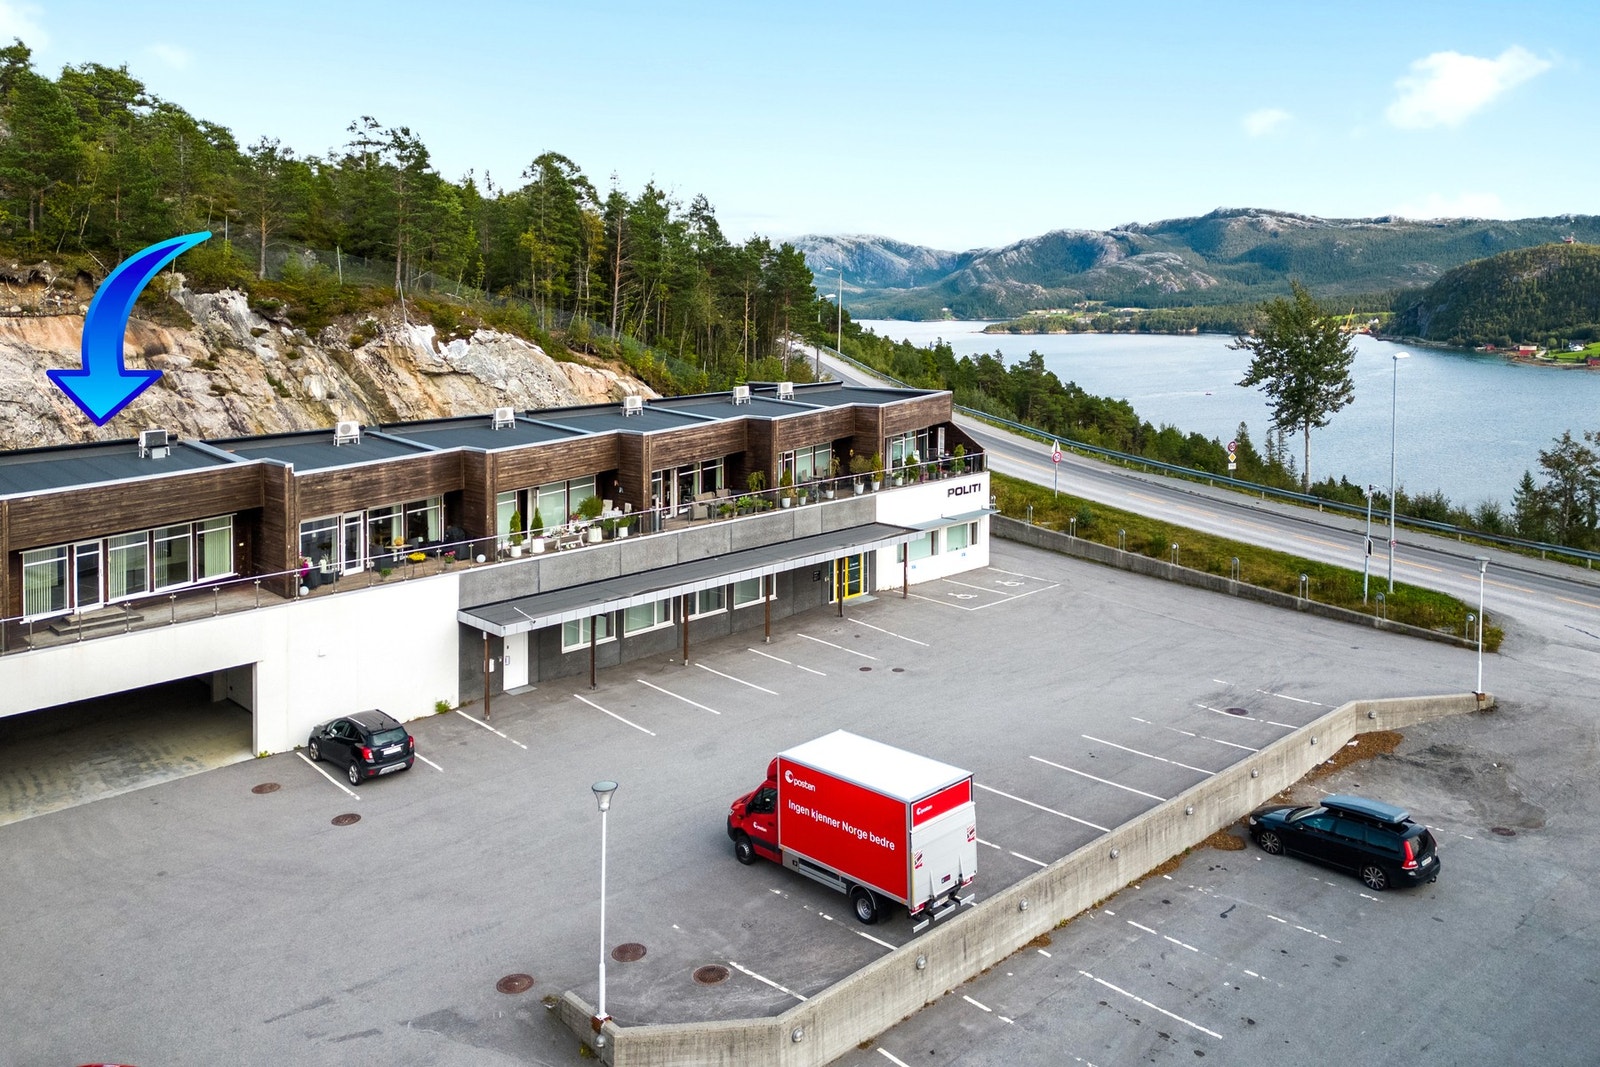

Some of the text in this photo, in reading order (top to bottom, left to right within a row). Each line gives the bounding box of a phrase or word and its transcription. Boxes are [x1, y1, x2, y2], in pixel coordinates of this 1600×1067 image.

[947, 483, 981, 498] POLITI
[793, 778, 816, 792] posten
[788, 799, 895, 851] Ingen kjenner Norge bedre
